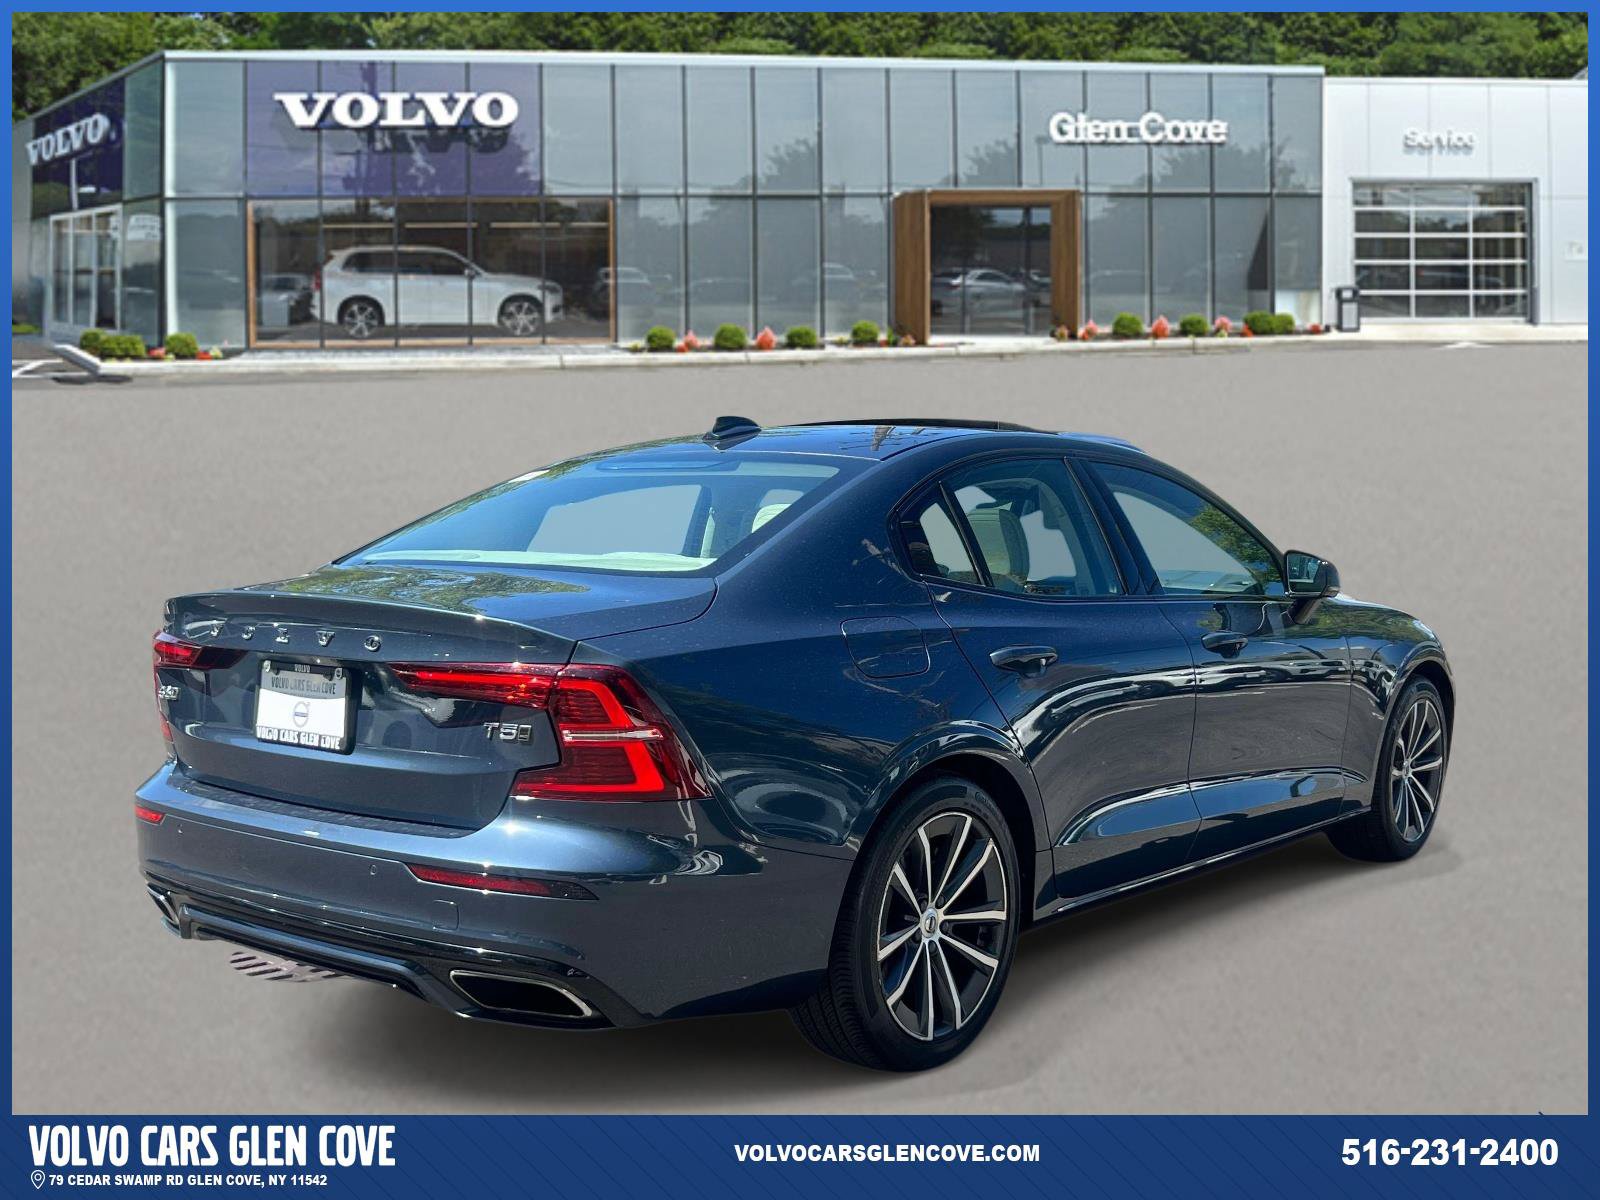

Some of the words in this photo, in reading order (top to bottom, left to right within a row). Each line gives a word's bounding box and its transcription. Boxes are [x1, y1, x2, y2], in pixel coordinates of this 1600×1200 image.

[274, 92, 519, 128] VOLVO
[26, 113, 110, 166] VOLVO
[1049, 112, 1129, 144] Glen
[1139, 112, 1228, 144] Cove
[1402, 128, 1476, 154] Service
[209, 620, 382, 651] VOLVO
[294, 663, 311, 673] VOLVO
[271, 676, 289, 689] VOLVO
[321, 681, 337, 695] COVE
[256, 726, 279, 741] VOLVO
[279, 729, 299, 744] CARS
[300, 731, 320, 747] GLEN
[321, 735, 341, 750] COVE
